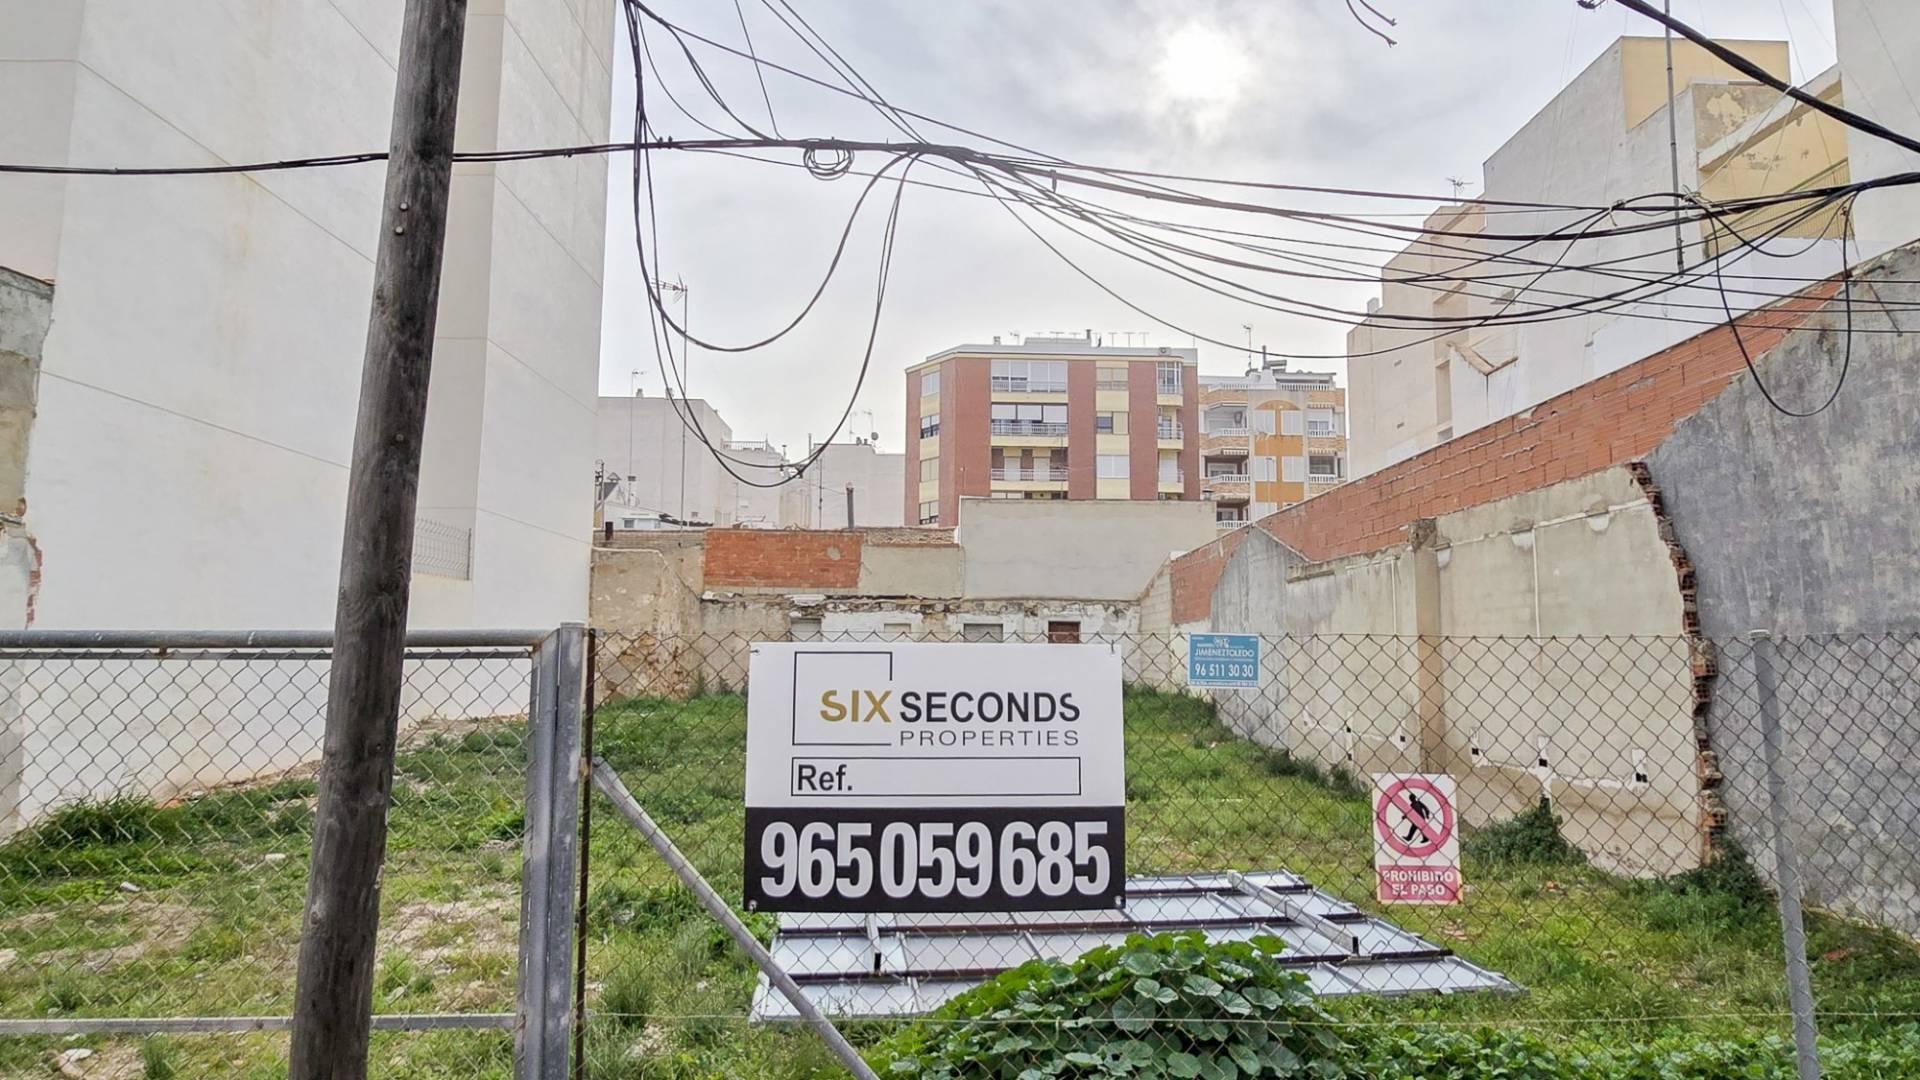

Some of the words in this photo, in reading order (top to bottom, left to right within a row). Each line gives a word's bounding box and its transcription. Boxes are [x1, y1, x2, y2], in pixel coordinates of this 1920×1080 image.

[1195, 663, 1206, 676] 96
[1209, 664, 1225, 676] 511
[1228, 664, 1240, 677] 30
[1242, 664, 1254, 677] 30
[819, 690, 892, 723] SIX
[900, 691, 1080, 723] SECONDS
[900, 730, 1079, 746] PROPERTIES
[797, 764, 853, 791] Ref.
[761, 821, 873, 898] 965
[880, 821, 993, 898] 059
[1001, 821, 1111, 897] 685
[1383, 870, 1454, 882] PROHIBIDO
[1392, 884, 1408, 895] EL
[1411, 884, 1446, 895] PASO
